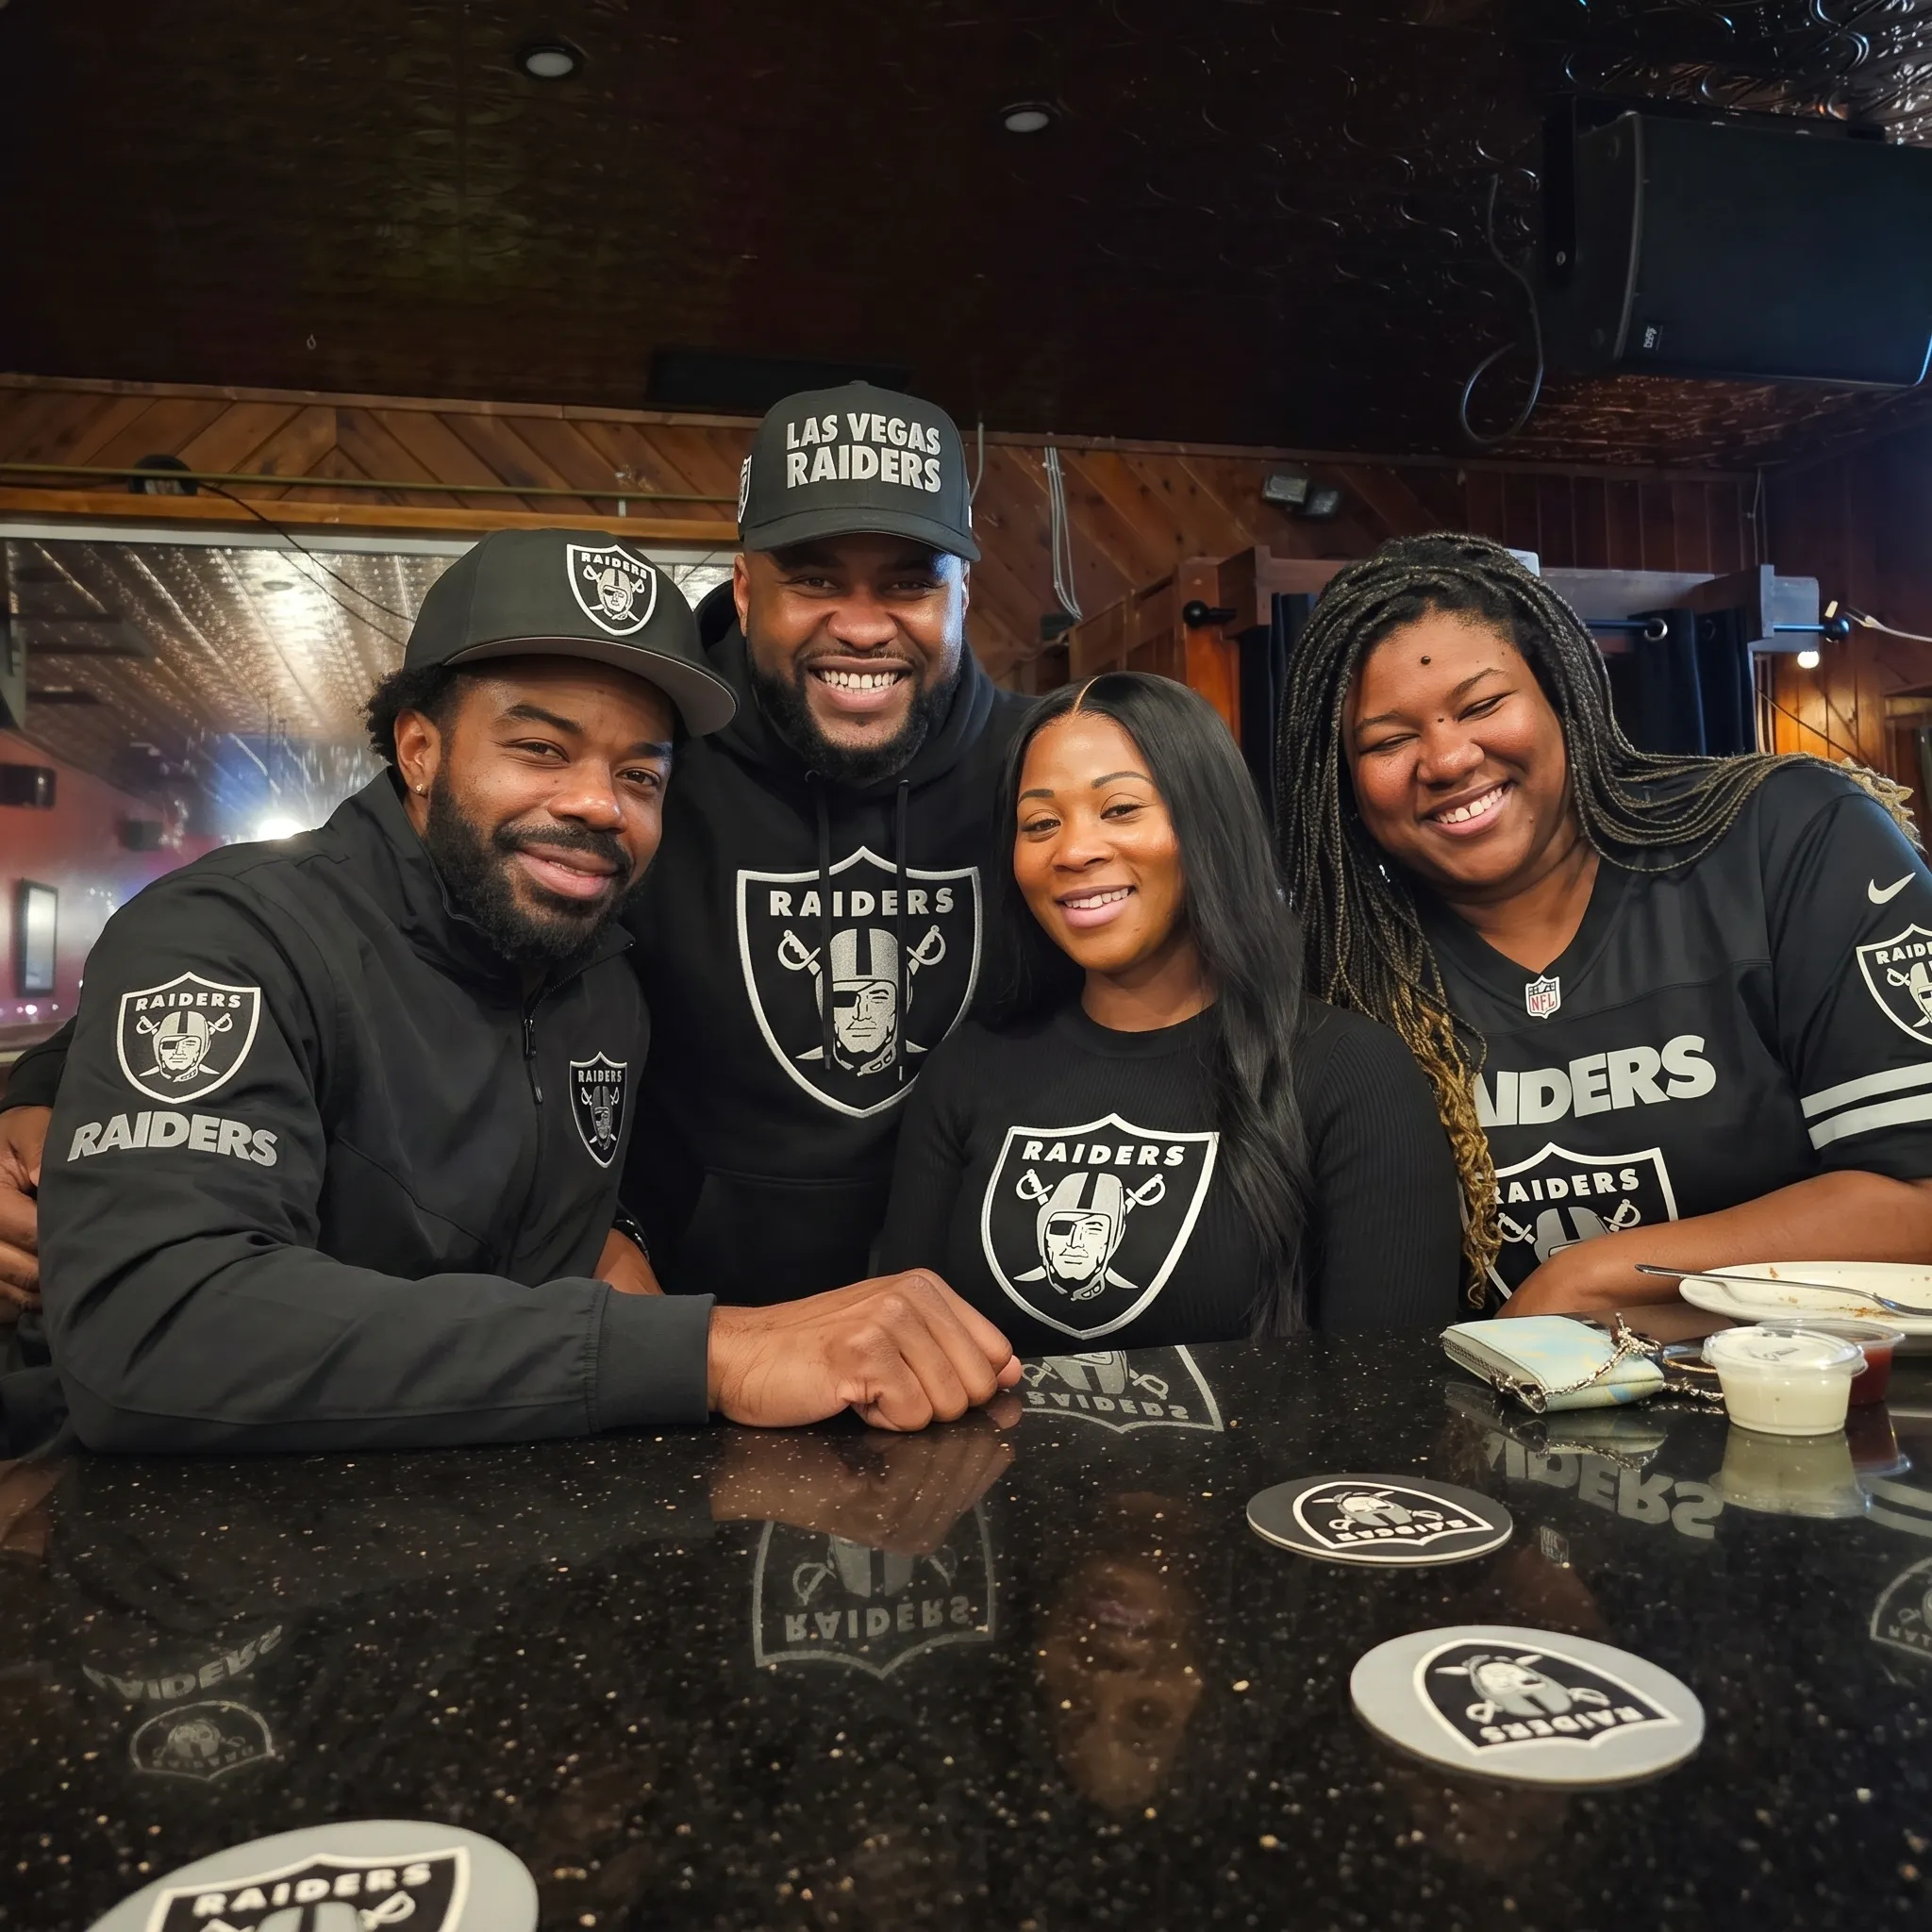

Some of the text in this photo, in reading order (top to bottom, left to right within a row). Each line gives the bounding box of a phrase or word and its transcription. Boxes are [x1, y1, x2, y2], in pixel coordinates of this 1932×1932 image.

[787, 412, 941, 456] LAS VEGAS
[787, 444, 941, 493] RAIDERS
[770, 888, 954, 917] RAIDERS
[135, 992, 242, 1011] RAIDERS
[1531, 993, 1555, 1011] NFL
[578, 1070, 622, 1083] RAIDERS
[67, 1111, 278, 1167] RAIDERS
[1022, 1141, 1186, 1167] RAIDERS
[1479, 1706, 1645, 1743] RAIDERS
[192, 1862, 432, 1917] RAIDERS
